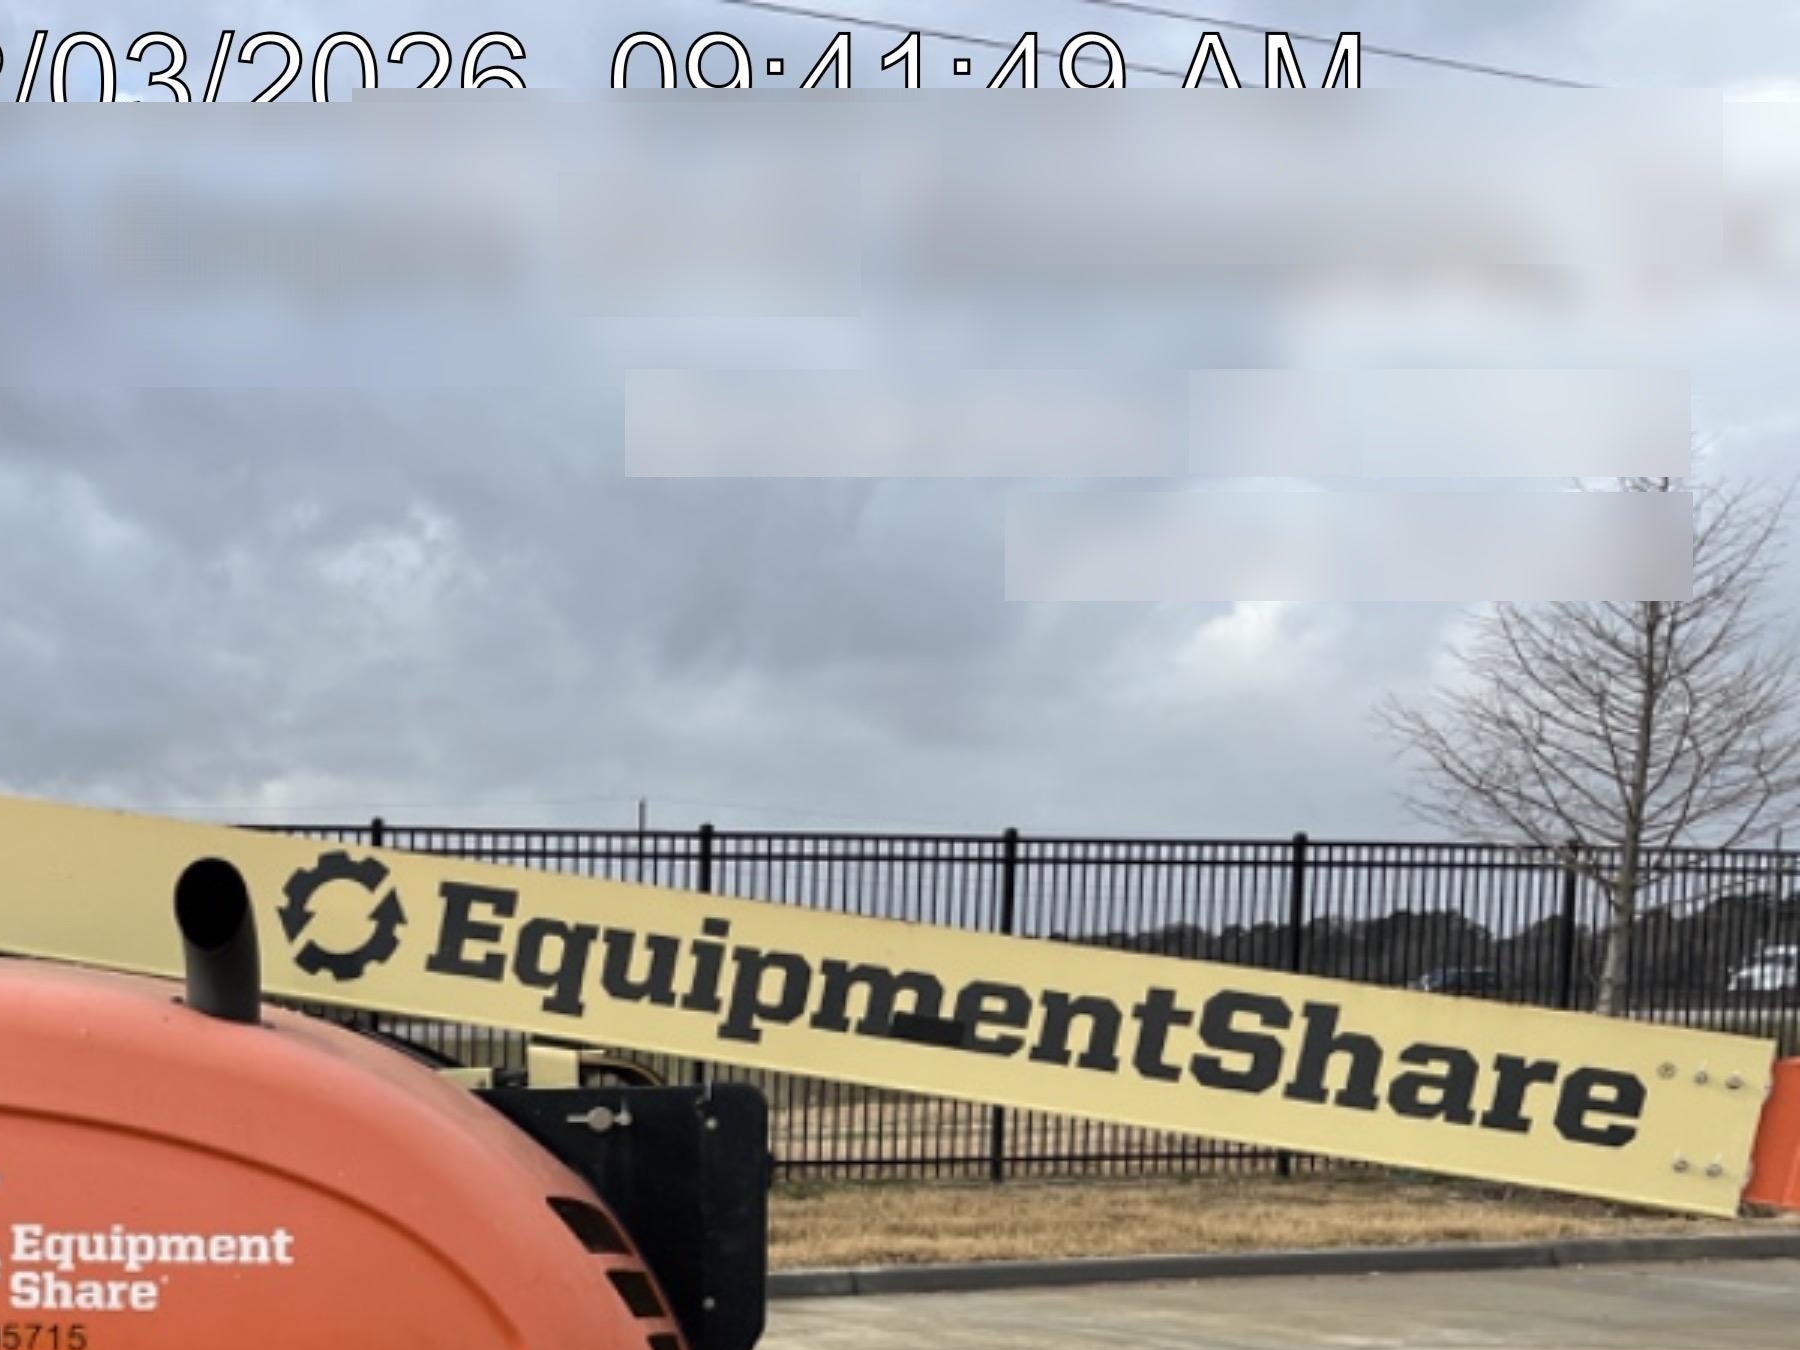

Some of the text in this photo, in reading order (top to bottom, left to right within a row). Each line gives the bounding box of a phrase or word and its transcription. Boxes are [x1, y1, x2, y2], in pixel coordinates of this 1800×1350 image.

[426, 881, 1647, 1147] EquipmentShare
[9, 1224, 294, 1272] Equipment
[9, 1271, 158, 1311] Share
